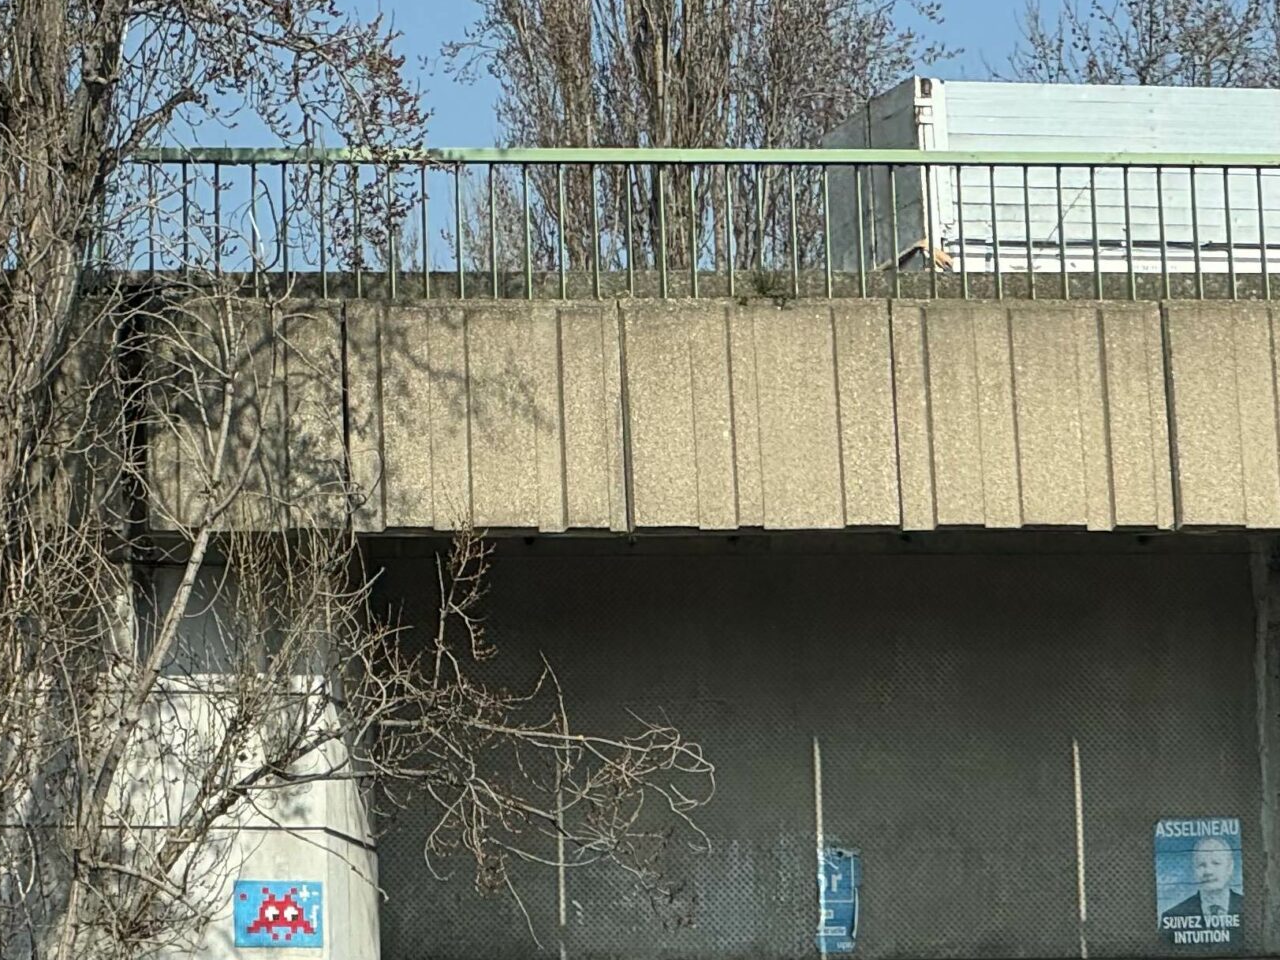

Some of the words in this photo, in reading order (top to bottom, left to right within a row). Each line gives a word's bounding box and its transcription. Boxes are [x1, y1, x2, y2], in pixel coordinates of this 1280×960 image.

[1155, 818, 1240, 838] ASSELINEAU
[1162, 915, 1202, 930] SUIVEZ
[1204, 914, 1240, 928] VOTRE
[1174, 929, 1231, 944] INTUITION
